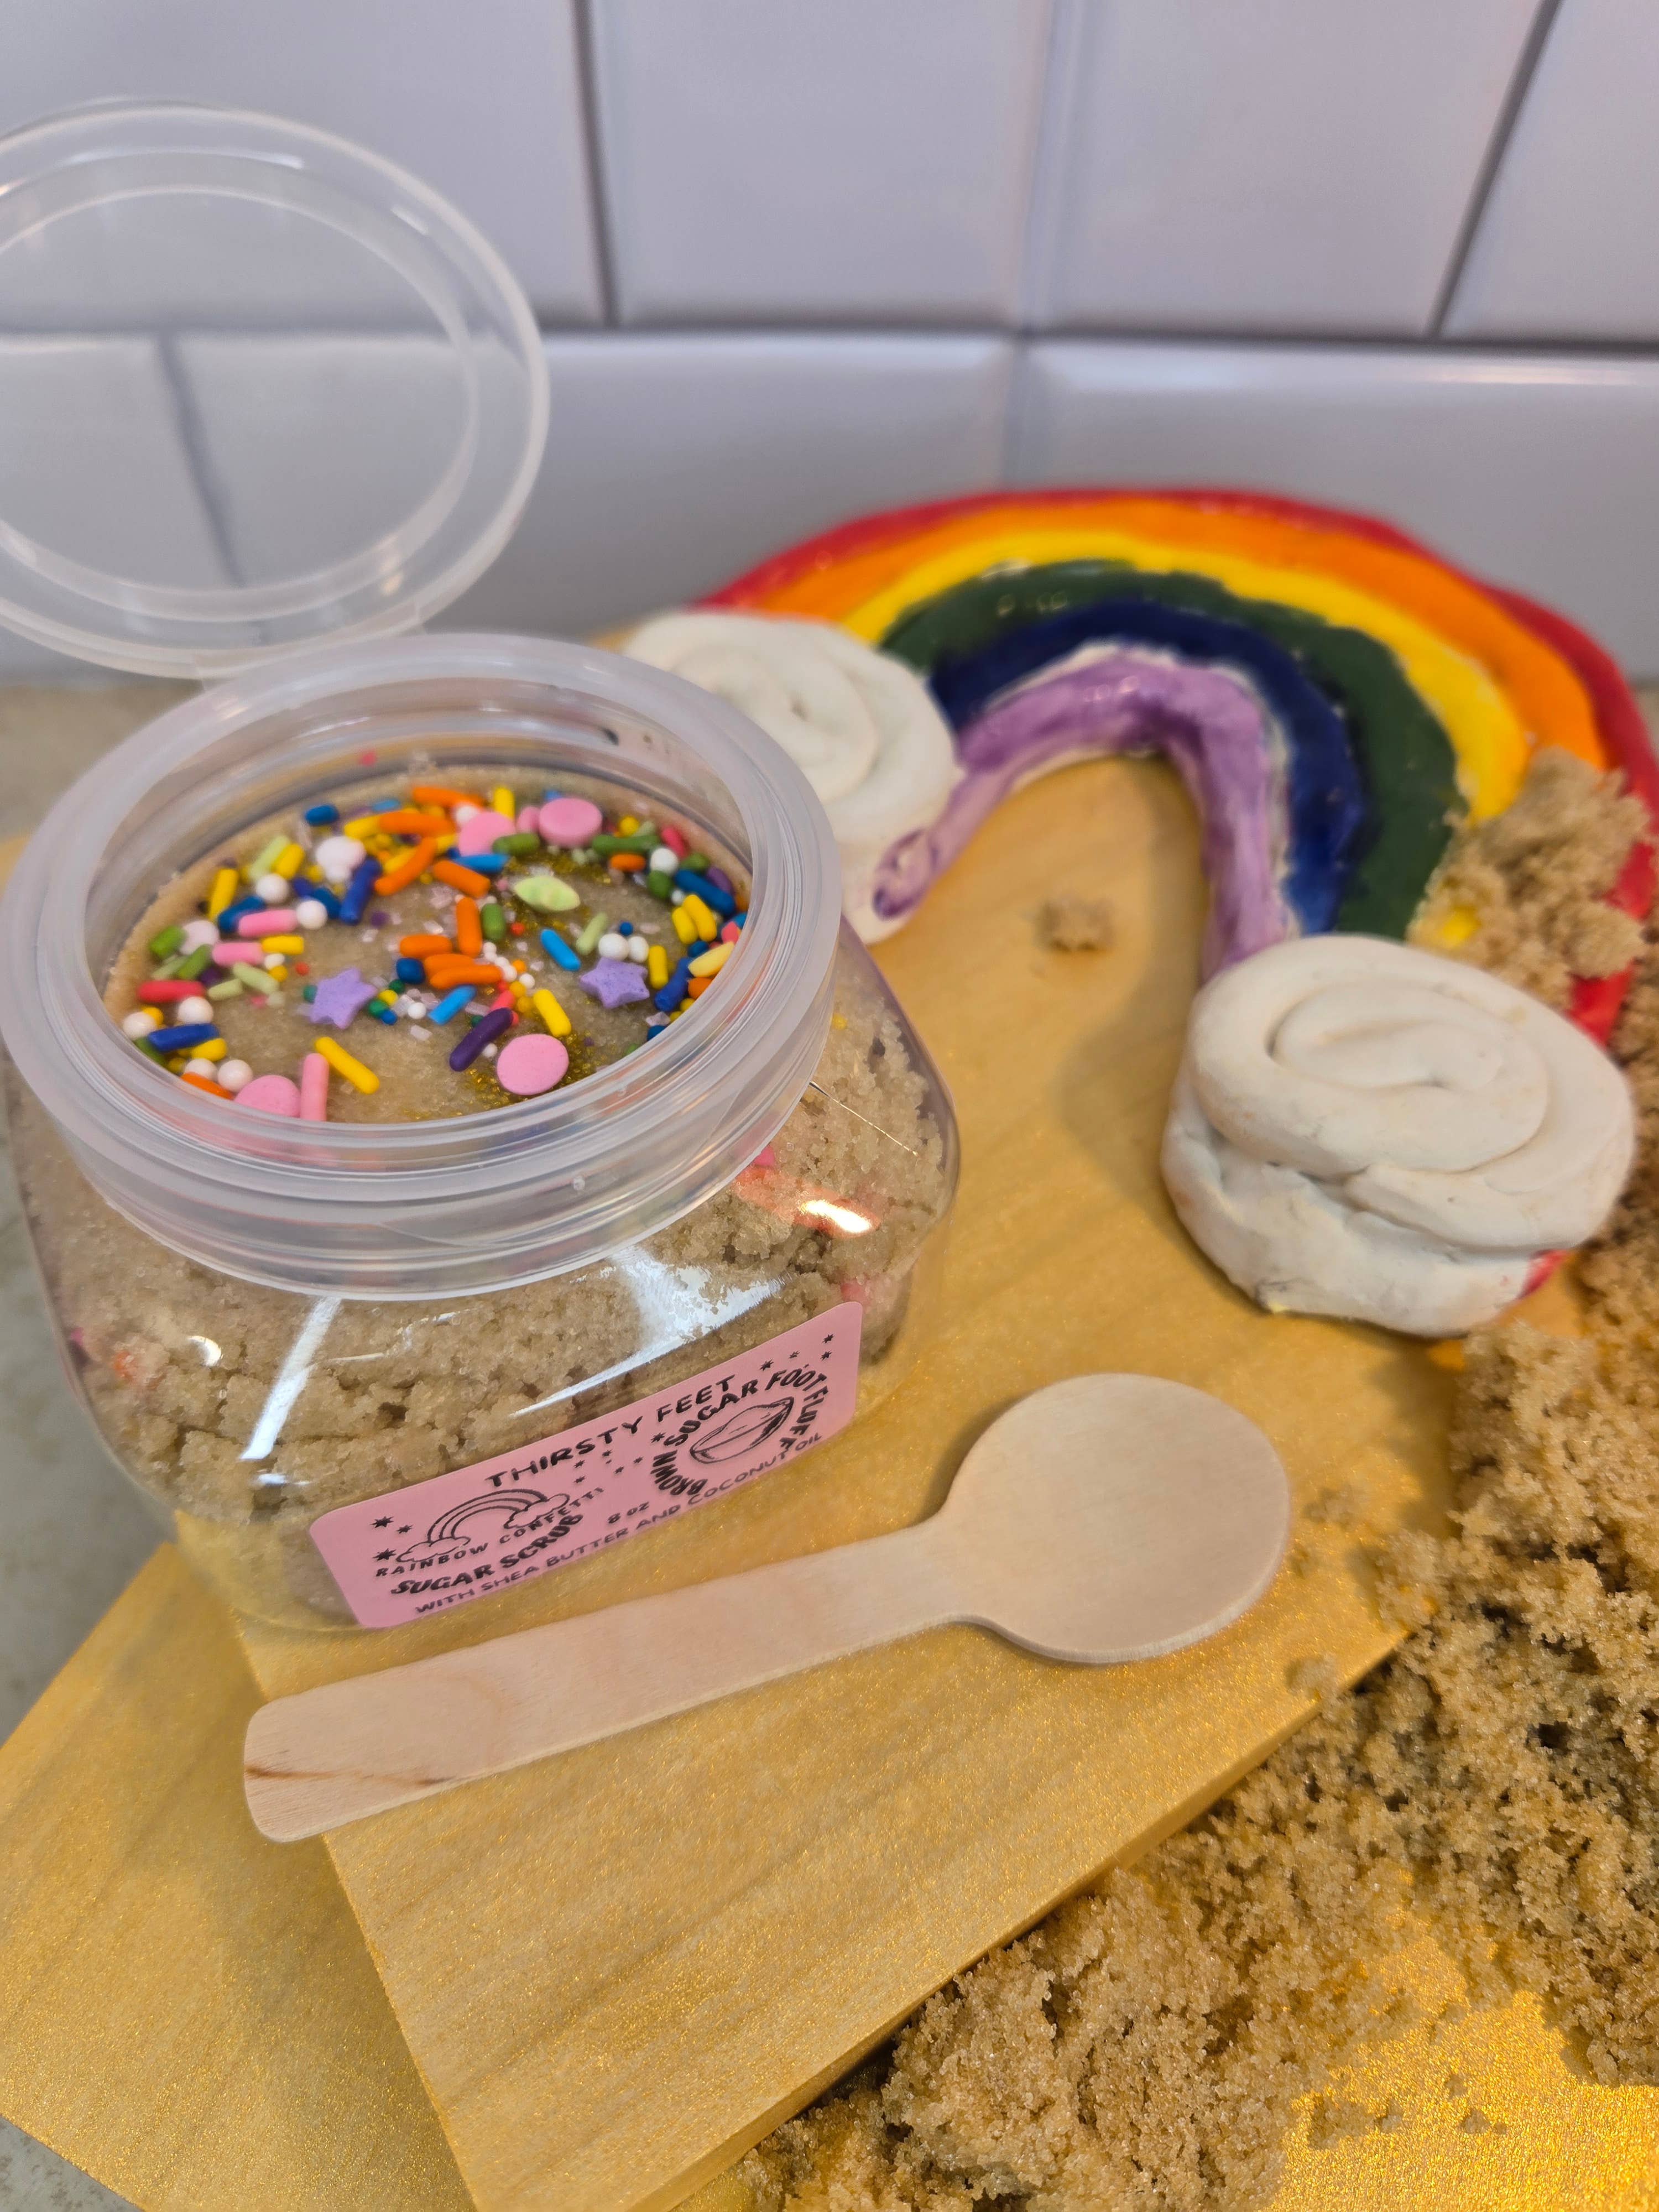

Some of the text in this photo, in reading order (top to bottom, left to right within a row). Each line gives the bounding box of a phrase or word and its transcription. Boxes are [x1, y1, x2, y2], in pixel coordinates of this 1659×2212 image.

[485, 1375, 735, 1487] THIRSTY FEET
[650, 1369, 828, 1495] BROWN SUGAR FOOT FLUFF
[375, 1487, 604, 1577] RAINBOW CONFETTI
[390, 1514, 584, 1595] SUGAR SCRUB
[416, 1433, 822, 1613] WITH SHEA BUTTER AND COCONUT OIL
[607, 1513, 621, 1525] 8
